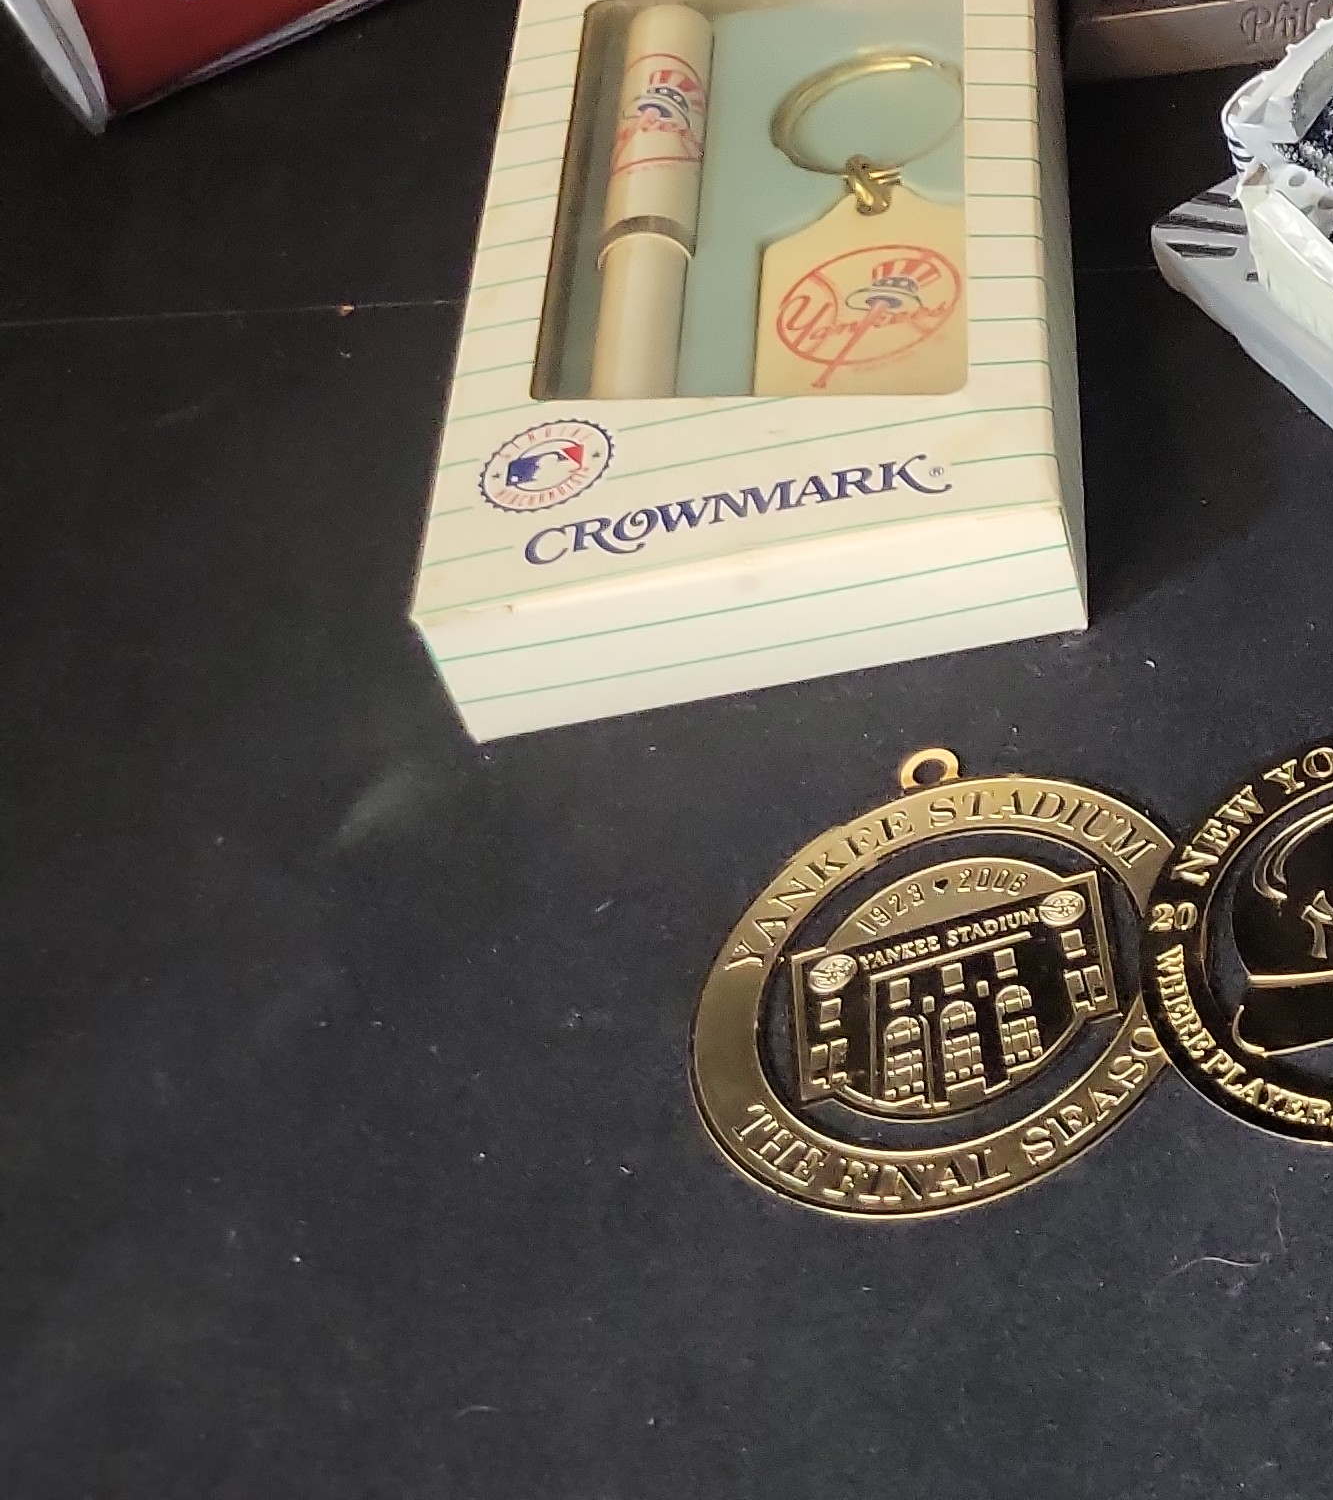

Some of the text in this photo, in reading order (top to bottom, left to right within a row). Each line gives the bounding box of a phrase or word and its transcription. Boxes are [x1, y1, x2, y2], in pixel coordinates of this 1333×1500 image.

[725, 789, 1161, 971] YANKEE STADIUM
[1170, 783, 1268, 887] NEW
[856, 882, 927, 937] 1923
[858, 904, 1041, 972] YANKEE STADIUM
[1147, 901, 1200, 934] 20
[1155, 943, 1213, 1060] WHERE
[730, 1101, 1012, 1202] THE FINAL
